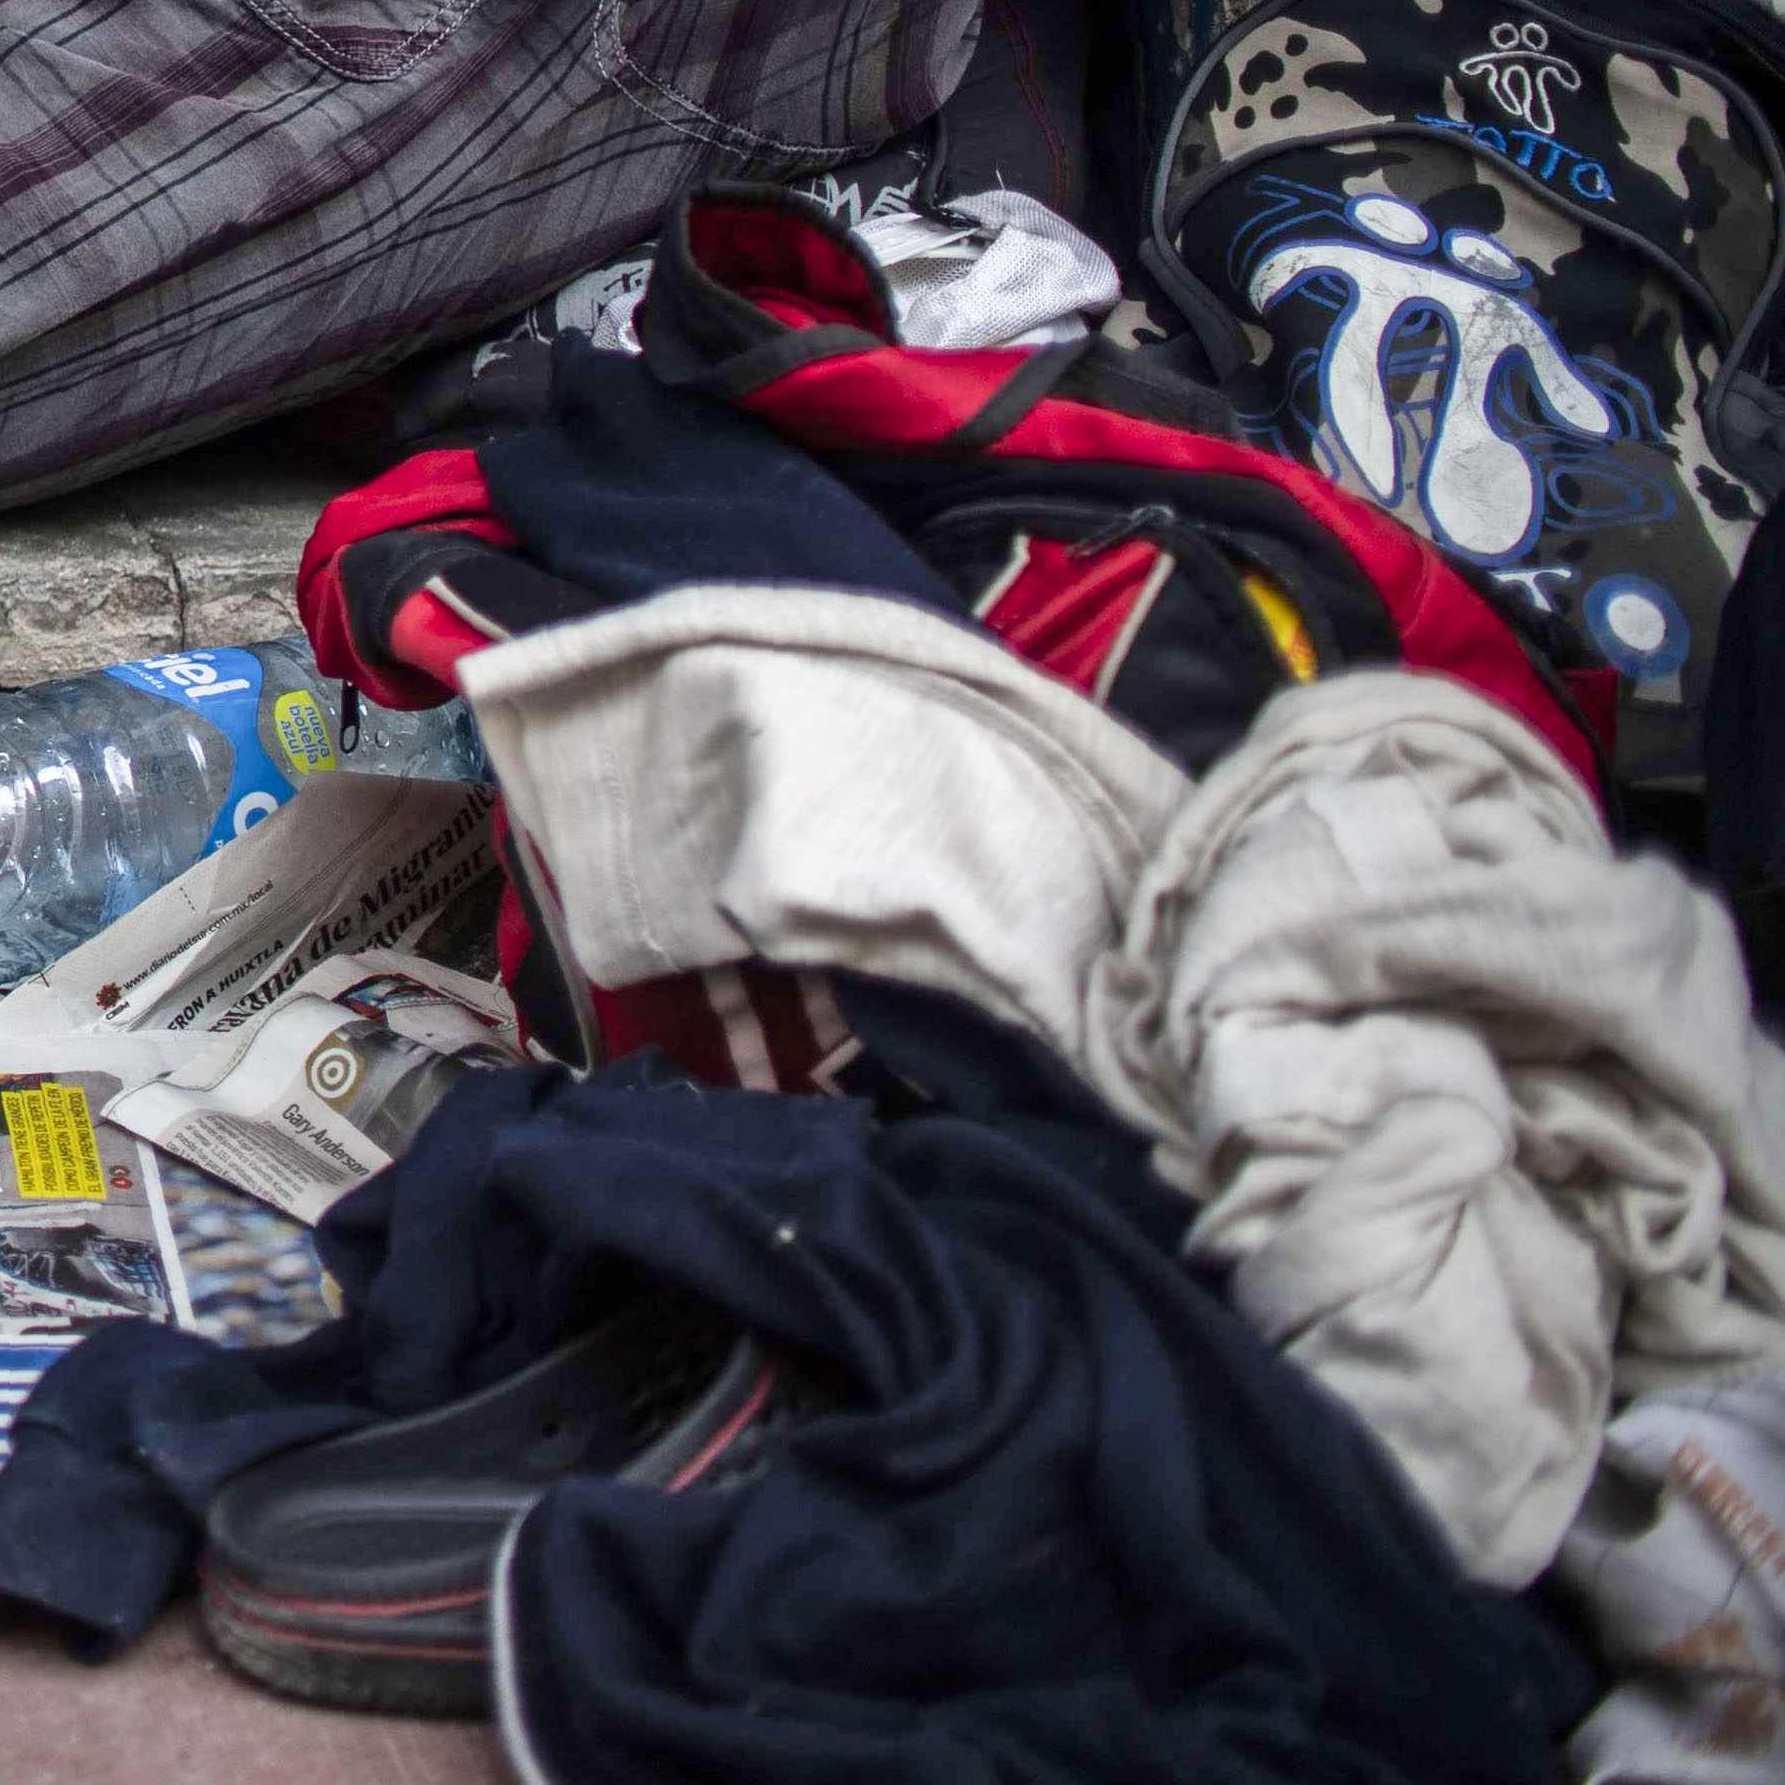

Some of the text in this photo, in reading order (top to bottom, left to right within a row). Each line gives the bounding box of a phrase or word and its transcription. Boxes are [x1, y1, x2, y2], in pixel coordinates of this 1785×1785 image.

[143, 652, 251, 699] iel
[280, 720, 304, 754] azul
[289, 705, 319, 764] botella
[304, 706, 331, 758] nueva
[122, 878, 275, 991] www.diariodelsur.com.mx/local
[309, 915, 352, 960] de
[205, 988, 218, 1004] A
[218, 939, 285, 993] HUIXTLA
[12, 1129, 31, 1151] TIENE
[281, 1103, 371, 1177] Gary Anderson
[17, 1151, 36, 1192] HAMILTON
[62, 1168, 81, 1192] COMO
[82, 1158, 100, 1182] GRAN
